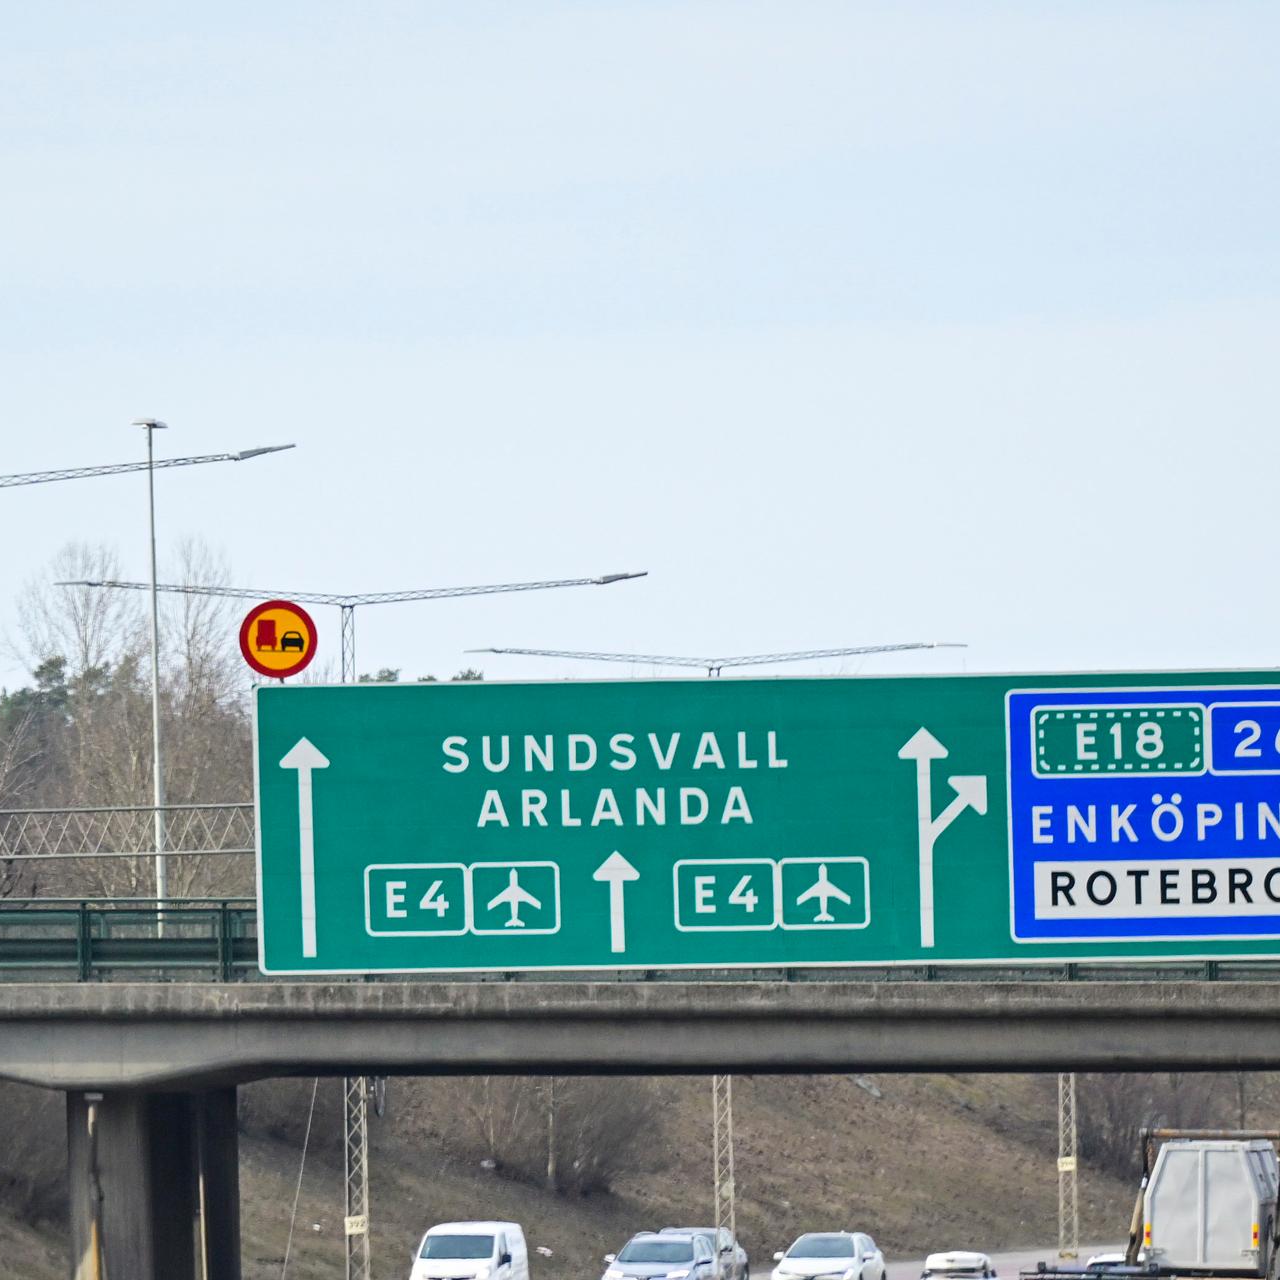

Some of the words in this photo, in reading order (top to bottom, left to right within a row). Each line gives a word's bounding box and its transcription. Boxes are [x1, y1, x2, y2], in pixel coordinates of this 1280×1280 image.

[442, 731, 788, 773] SUNDSVALL
[1076, 721, 1164, 761] E18
[477, 786, 753, 828] ARLANDA
[386, 880, 449, 918] E4
[694, 875, 758, 913] E4
